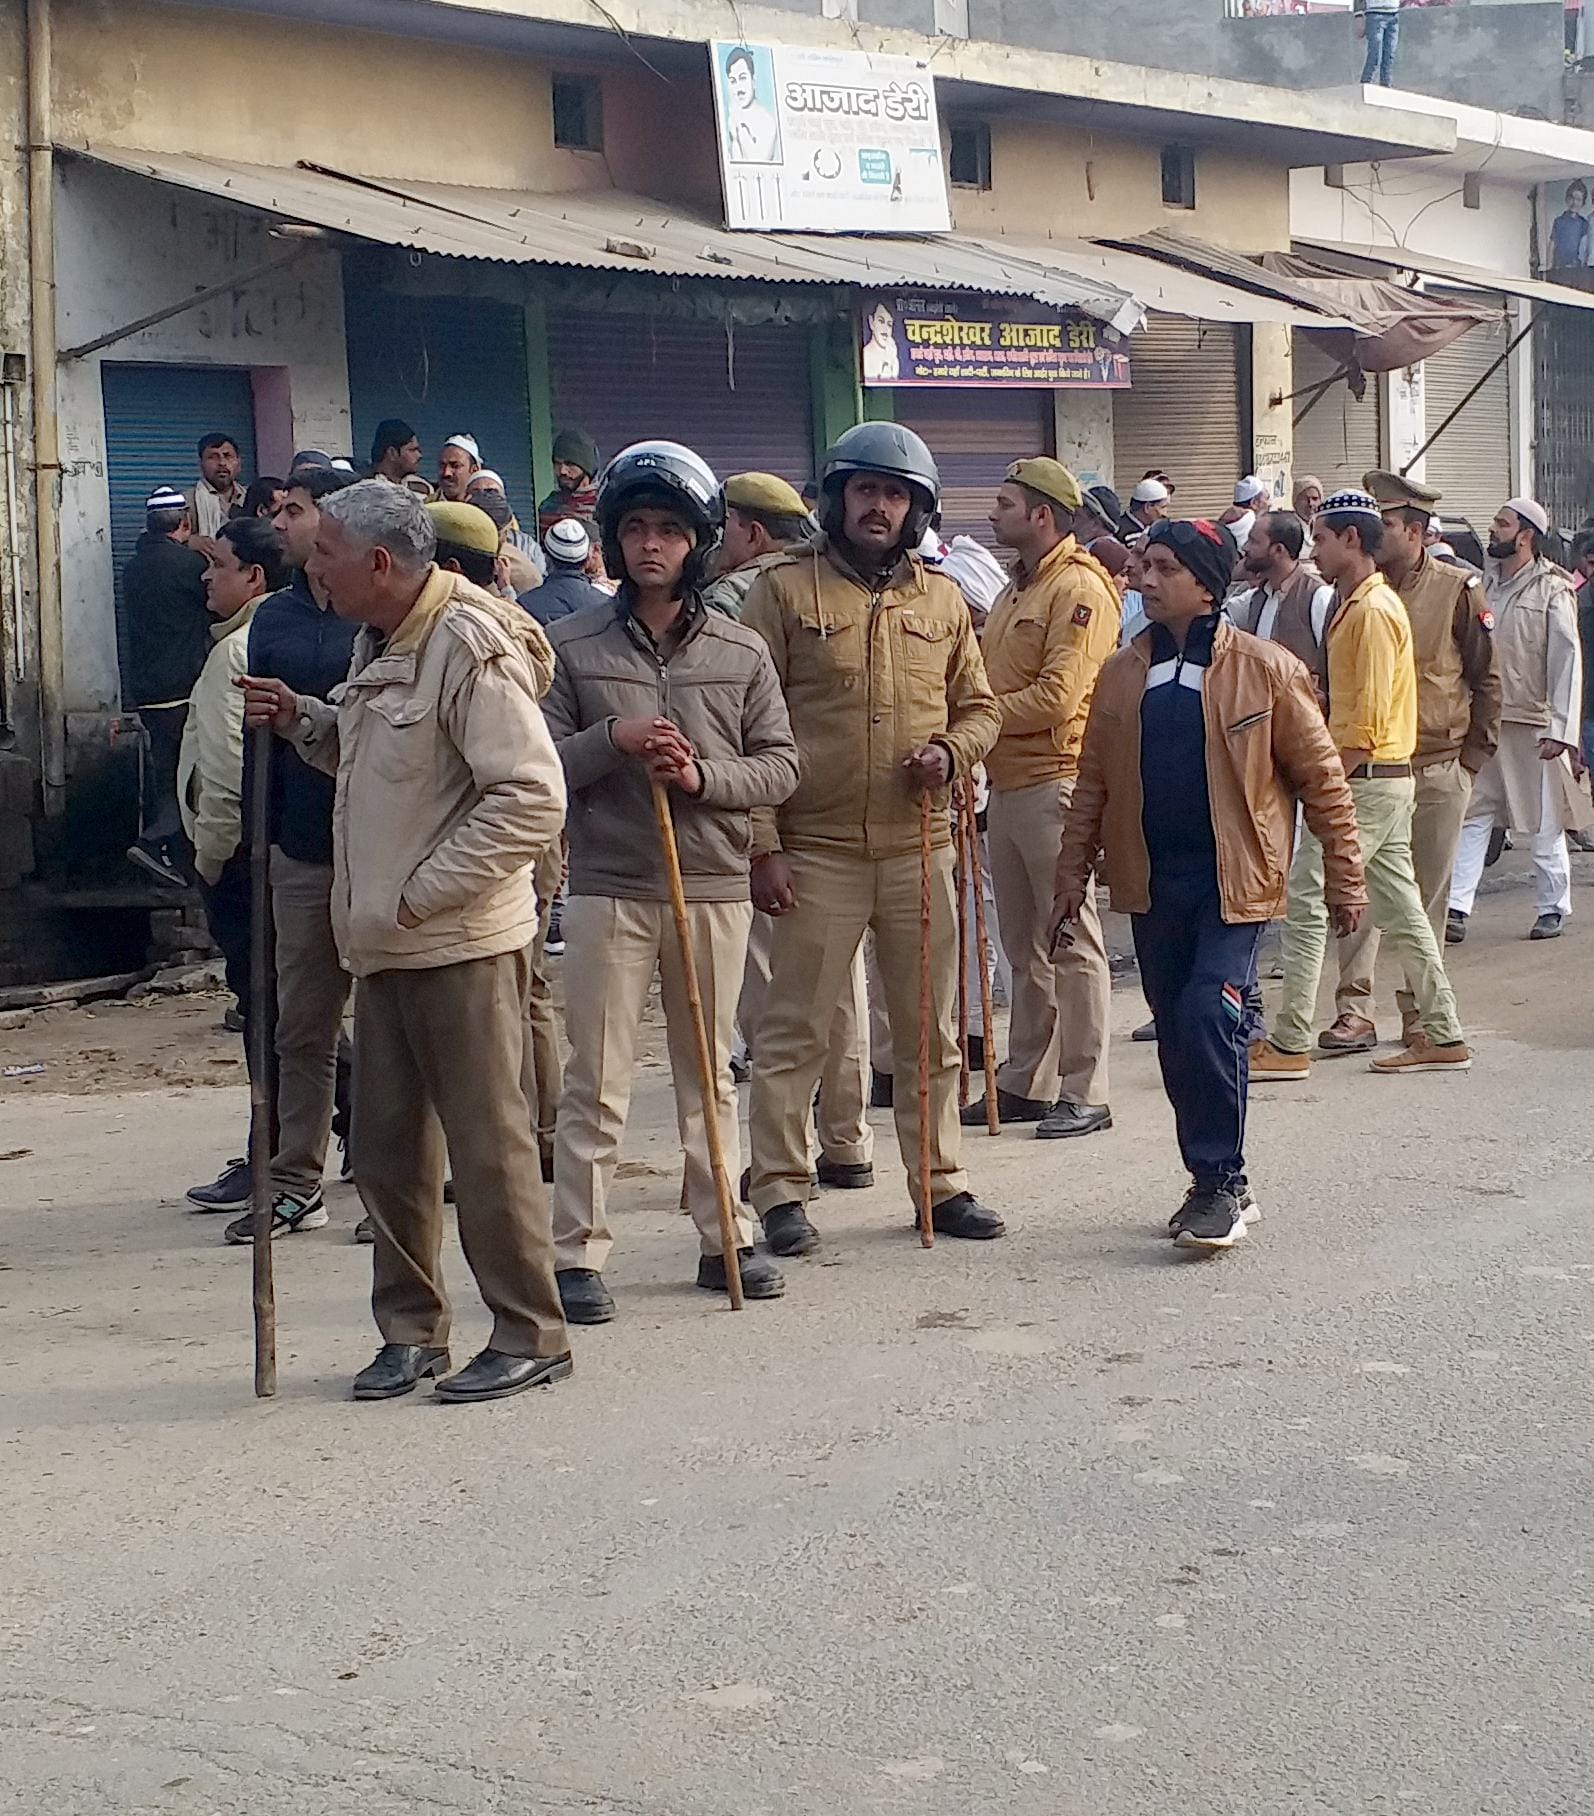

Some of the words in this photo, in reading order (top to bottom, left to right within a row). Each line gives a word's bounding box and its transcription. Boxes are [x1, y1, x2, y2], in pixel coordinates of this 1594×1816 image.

[785, 81, 879, 117] आजाद
[882, 80, 929, 121] डेरी
[904, 315, 992, 347] चन्द्रशेखर
[1000, 321, 1061, 348] आजाद
[1066, 320, 1097, 349] डेरी
